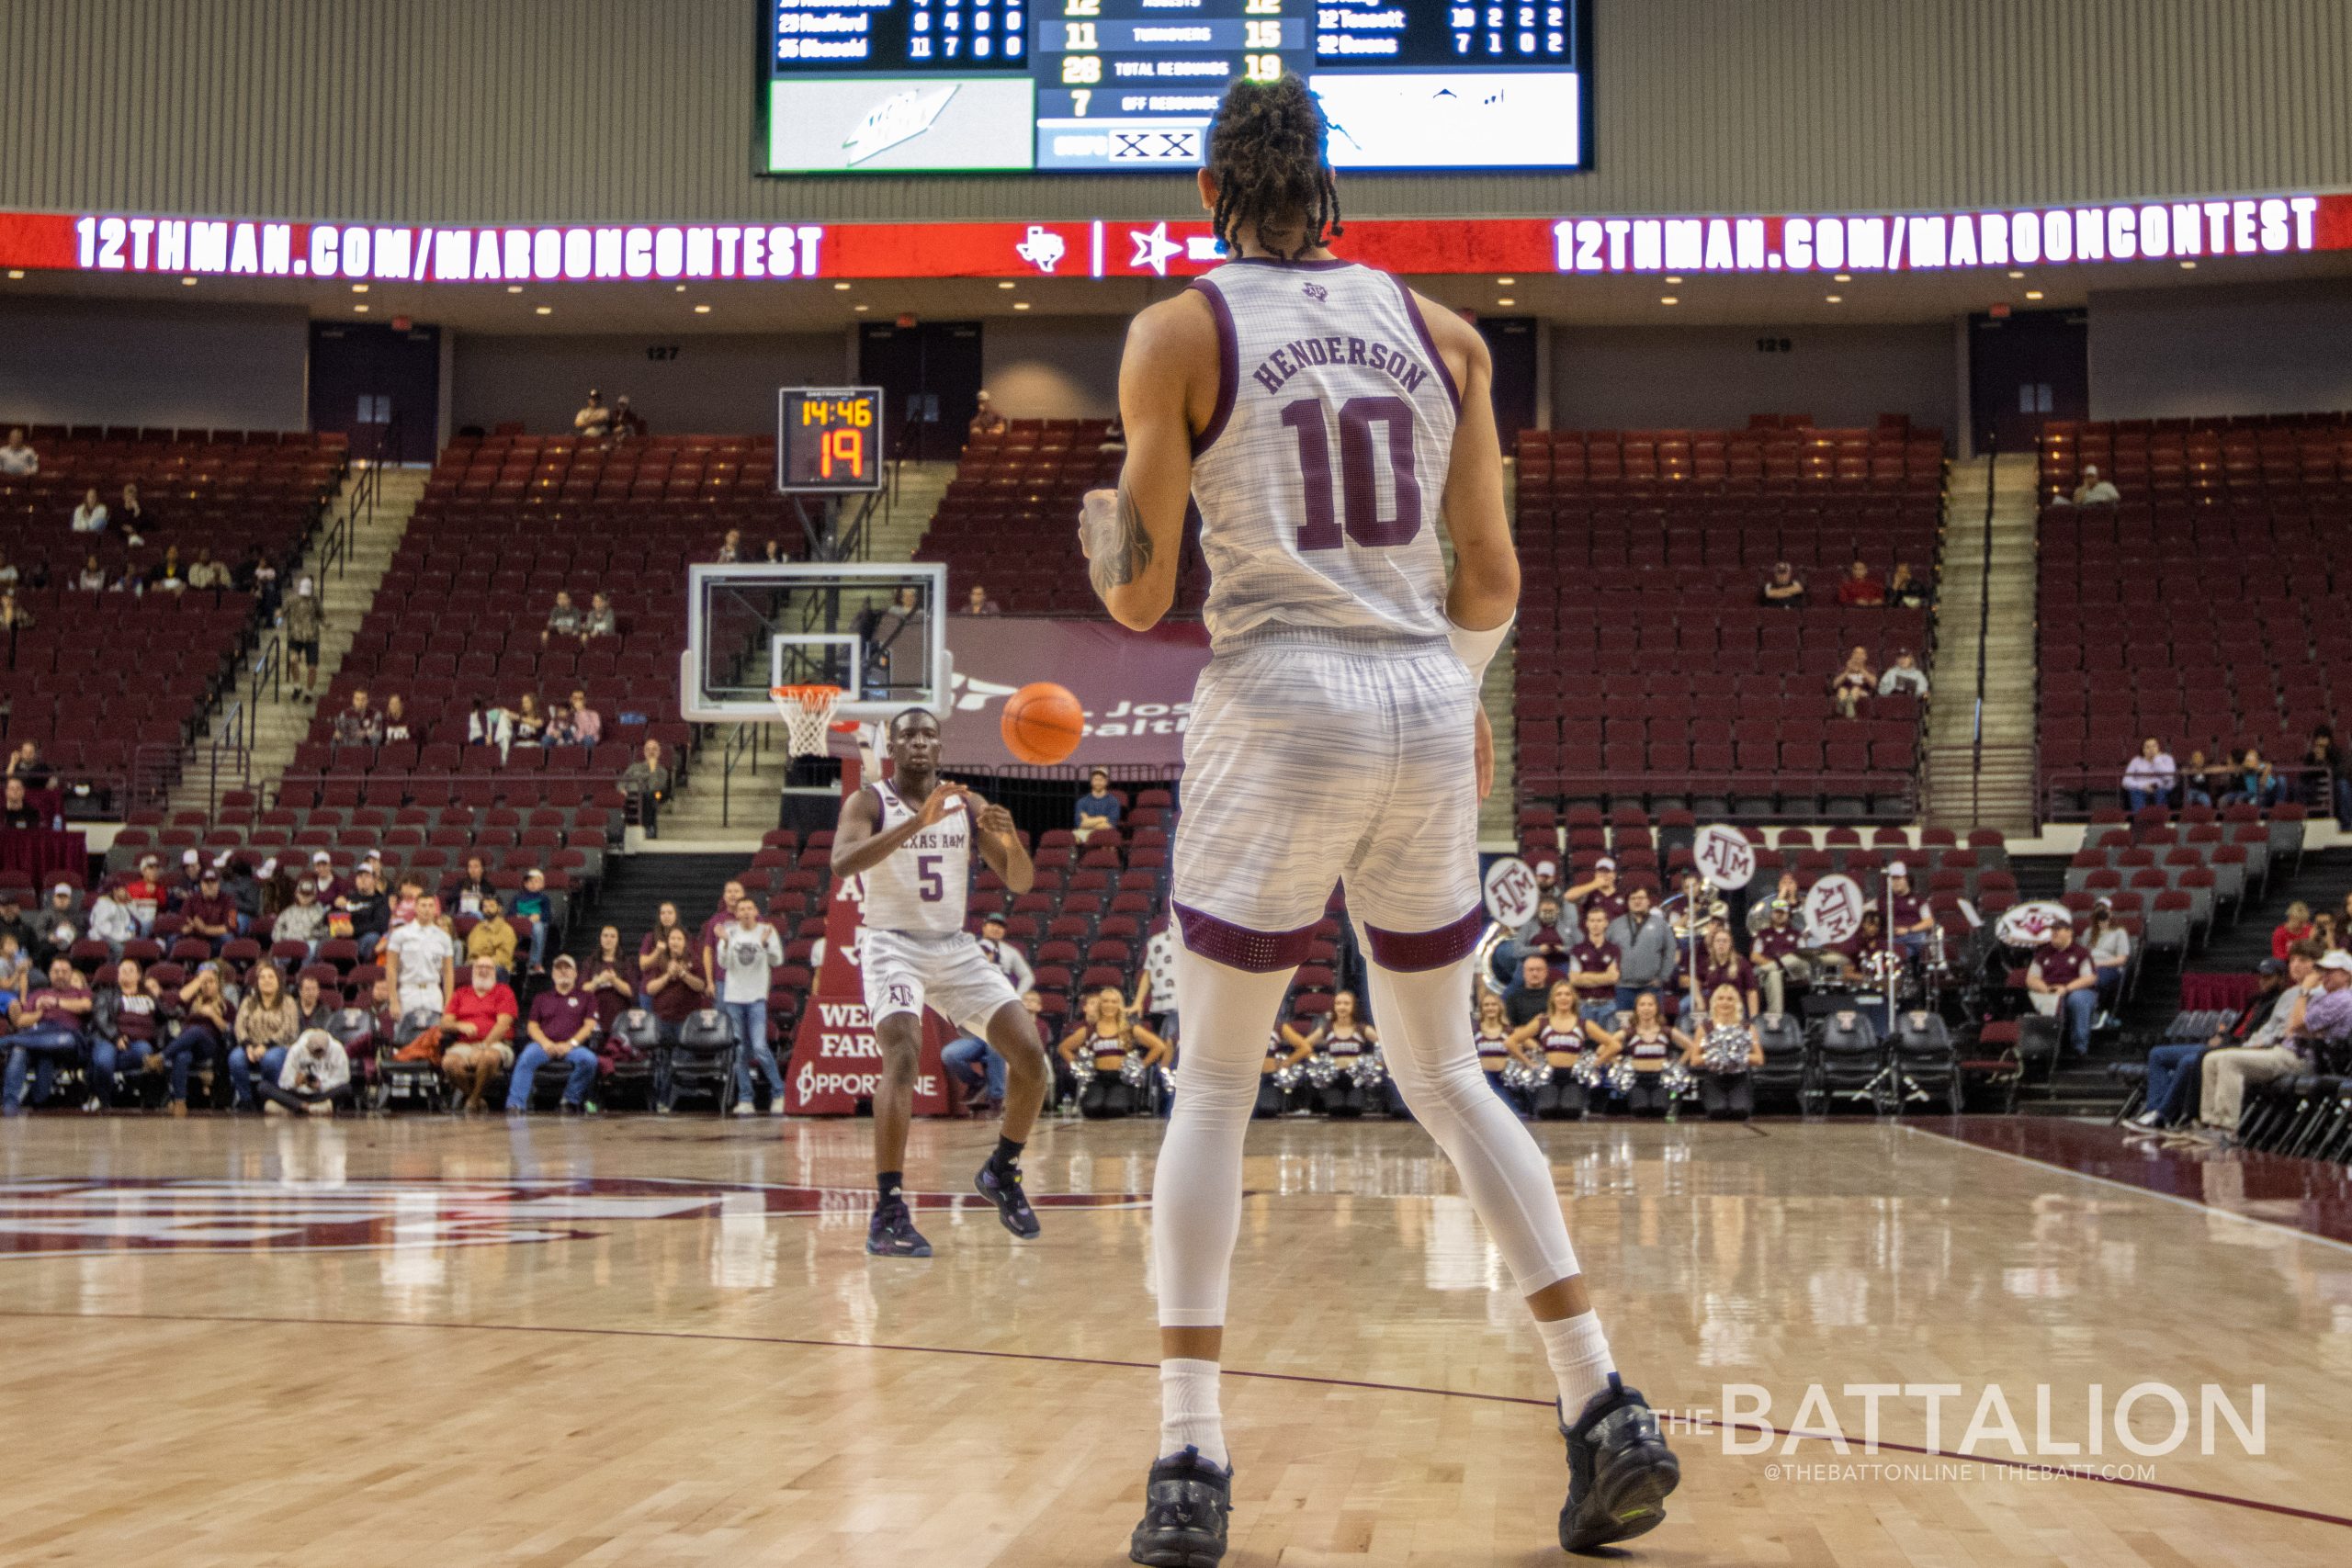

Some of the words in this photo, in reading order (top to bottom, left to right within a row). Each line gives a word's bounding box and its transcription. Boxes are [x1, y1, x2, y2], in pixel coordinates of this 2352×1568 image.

[944, 12, 959, 30] 4
[1487, 8, 1503, 27] 2
[1520, 7, 1534, 27] 2
[1547, 7, 1563, 27] 2
[910, 37, 931, 57] 11
[944, 37, 958, 56] 7
[1065, 22, 1098, 50] 11
[1245, 21, 1281, 48] 15
[1455, 33, 1470, 52] 7
[1488, 33, 1502, 52] 1
[1547, 33, 1563, 52] 2
[1114, 62, 1154, 76] TOTAL
[1245, 54, 1282, 80] 19
[1070, 89, 1091, 117] 7
[1554, 197, 2317, 270] 12THMAN.COM/MAROONCONTEST
[77, 217, 822, 280] 12THMAN.COM/MAROONCONTEST
[1252, 336, 1428, 395] HENDERSON
[802, 398, 873, 428] 14:46
[820, 428, 863, 479] 19
[1281, 396, 1421, 551] 10
[942, 834, 965, 848] A&M
[917, 855, 944, 902] 5
